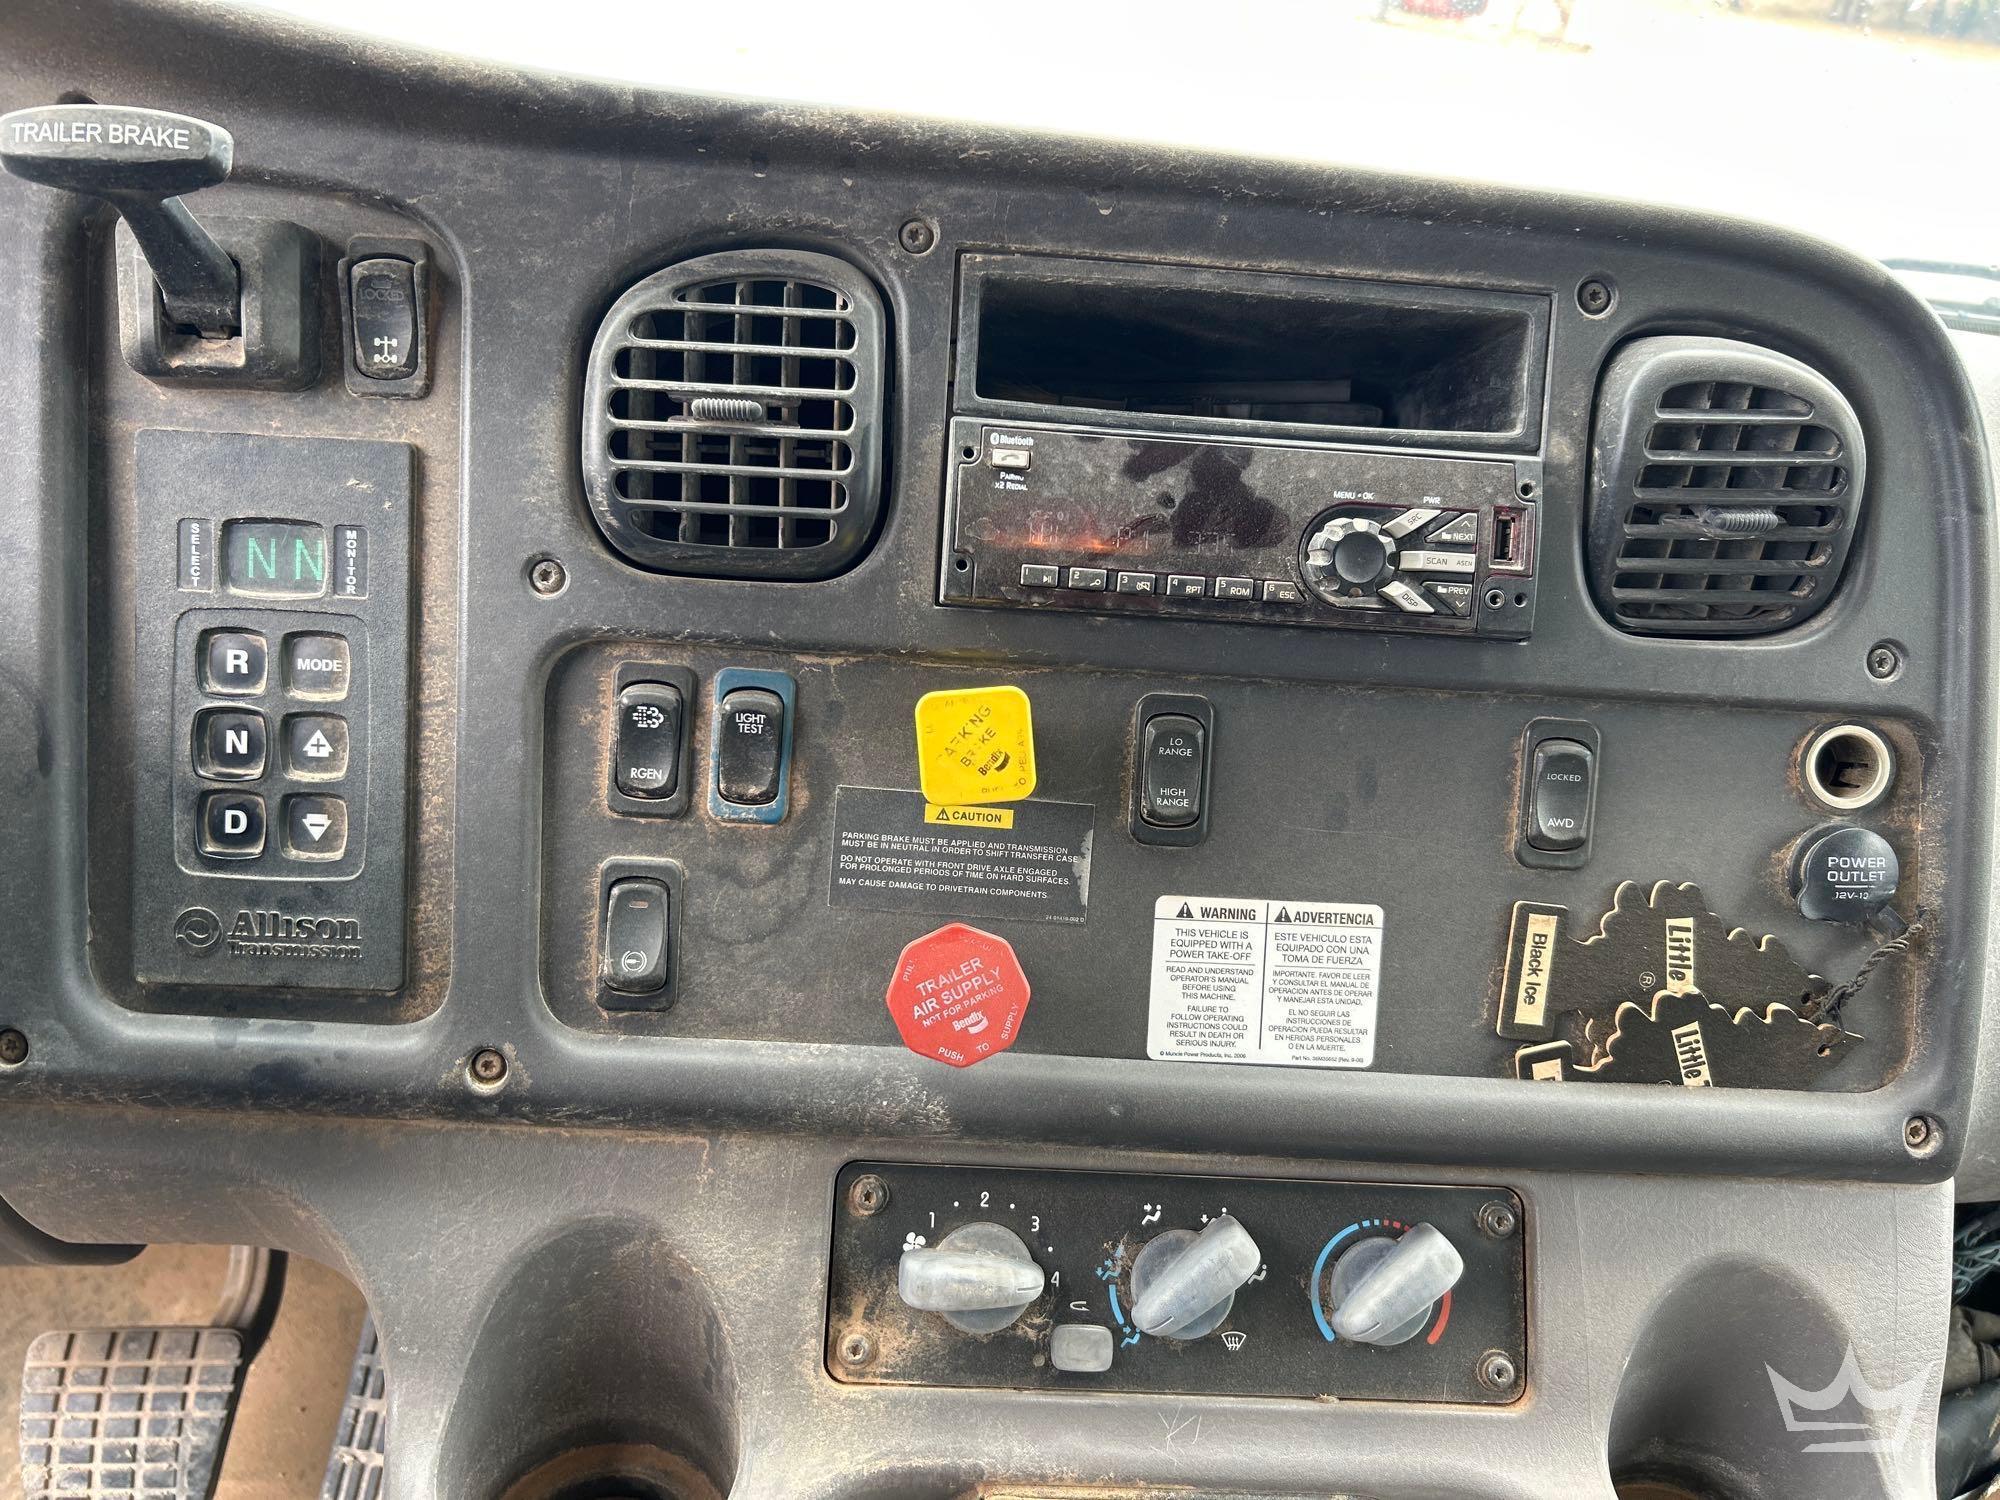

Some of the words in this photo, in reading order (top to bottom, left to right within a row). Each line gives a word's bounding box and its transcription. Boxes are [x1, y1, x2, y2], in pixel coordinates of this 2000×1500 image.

[11, 122, 102, 144] TRAILER
[108, 123, 190, 150] BRAKE
[360, 289, 404, 300] LOCKED
[1000, 434, 1034, 446] Bluetooth
[1334, 491, 1355, 499] MENU
[1363, 492, 1374, 500] OK
[1408, 513, 1422, 525] SRC
[192, 523, 200, 587] SELECT
[249, 538, 275, 578] N
[296, 539, 322, 580] N
[1426, 557, 1447, 565] SCAN
[346, 530, 357, 594] MONITOR
[1280, 591, 1295, 599] ESC
[1448, 587, 1469, 595] PREV
[1402, 593, 1419, 608] DISP
[226, 650, 248, 673] R
[298, 659, 342, 672] MODE
[736, 713, 767, 724] LIGHT
[738, 724, 763, 734] TEST
[226, 730, 248, 754] N
[1170, 738, 1182, 746] LO
[1159, 748, 1192, 756] RANGE
[631, 768, 662, 779] RGEN
[1547, 773, 1581, 781] LOCKED
[1161, 788, 1186, 796] HIGH
[1157, 798, 1189, 807] RANGE
[225, 810, 247, 833] D
[952, 812, 1001, 823] CAUTION
[1548, 818, 1574, 828] AWD
[842, 832, 879, 840] PARKING
[882, 834, 909, 843] BRAKE
[950, 838, 986, 848] APPLIED
[1007, 844, 1068, 854] TRANSMISSION
[842, 839, 865, 847] MUST
[891, 842, 929, 852] NEUTRAL
[942, 846, 972, 855] ORDER
[986, 849, 1009, 858] SHIFT
[1011, 851, 1053, 860] TRANSFER
[874, 857, 912, 866] OPERATE
[937, 861, 965, 869] FRONT
[967, 863, 991, 871] DRIVE
[1017, 867, 1057, 876] ENGAGED
[1828, 857, 1886, 867] POWER
[860, 864, 912, 873] PROLONGED
[914, 868, 949, 876] PERIODS
[966, 871, 983, 879] TIME
[1827, 871, 1886, 882] OUTLET
[839, 877, 856, 885] MAY
[859, 879, 886, 887] CAUSE
[889, 881, 924, 890] DAMAGE
[938, 884, 988, 895] DRIVETRAIN
[1200, 907, 1256, 920] WARNING
[1294, 911, 1374, 925] ADVERTENCIA
[228, 910, 362, 939] Allison
[1176, 928, 1196, 937] THIS
[1199, 929, 1238, 939] VEHICLE
[1240, 931, 1249, 939] IS
[1275, 933, 1298, 941] ESTE
[1300, 934, 1347, 943] VEHICULO
[1350, 936, 1372, 944] ESTA
[1171, 939, 1217, 948] EQUIPPED
[1220, 941, 1243, 950] WITH
[1246, 942, 1252, 950] A
[1276, 943, 1323, 953] EQUIPADO
[1349, 947, 1369, 955] UNA
[1170, 950, 1204, 958] POWER
[1206, 951, 1251, 960] TAKE-OFF
[1282, 954, 1309, 963] TOMA
[1327, 957, 1362, 965] FUERZA
[1527, 932, 1548, 977] Black
[1668, 924, 1692, 982] Little
[916, 957, 984, 996] TRAILER
[1170, 974, 1216, 982] OPERATOR'S
[913, 997, 940, 1019] AIR
[941, 966, 1001, 1005] SUPPLY
[1523, 982, 1540, 1006] Ice
[922, 1015, 941, 1028] NOT
[942, 1005, 962, 1018] FOR
[964, 984, 1004, 1008] PARKING
[952, 1010, 984, 1032] Bendix
[1001, 1003, 1019, 1040] SUPPLY
[976, 1042, 990, 1053] TO
[938, 1047, 964, 1062] PUSH
[1674, 1029, 1702, 1080] Little
[980, 1192, 990, 1207] 2
[929, 1212, 934, 1228] 1
[1031, 1216, 1040, 1231] 3
[1051, 1271, 1060, 1287] 4
